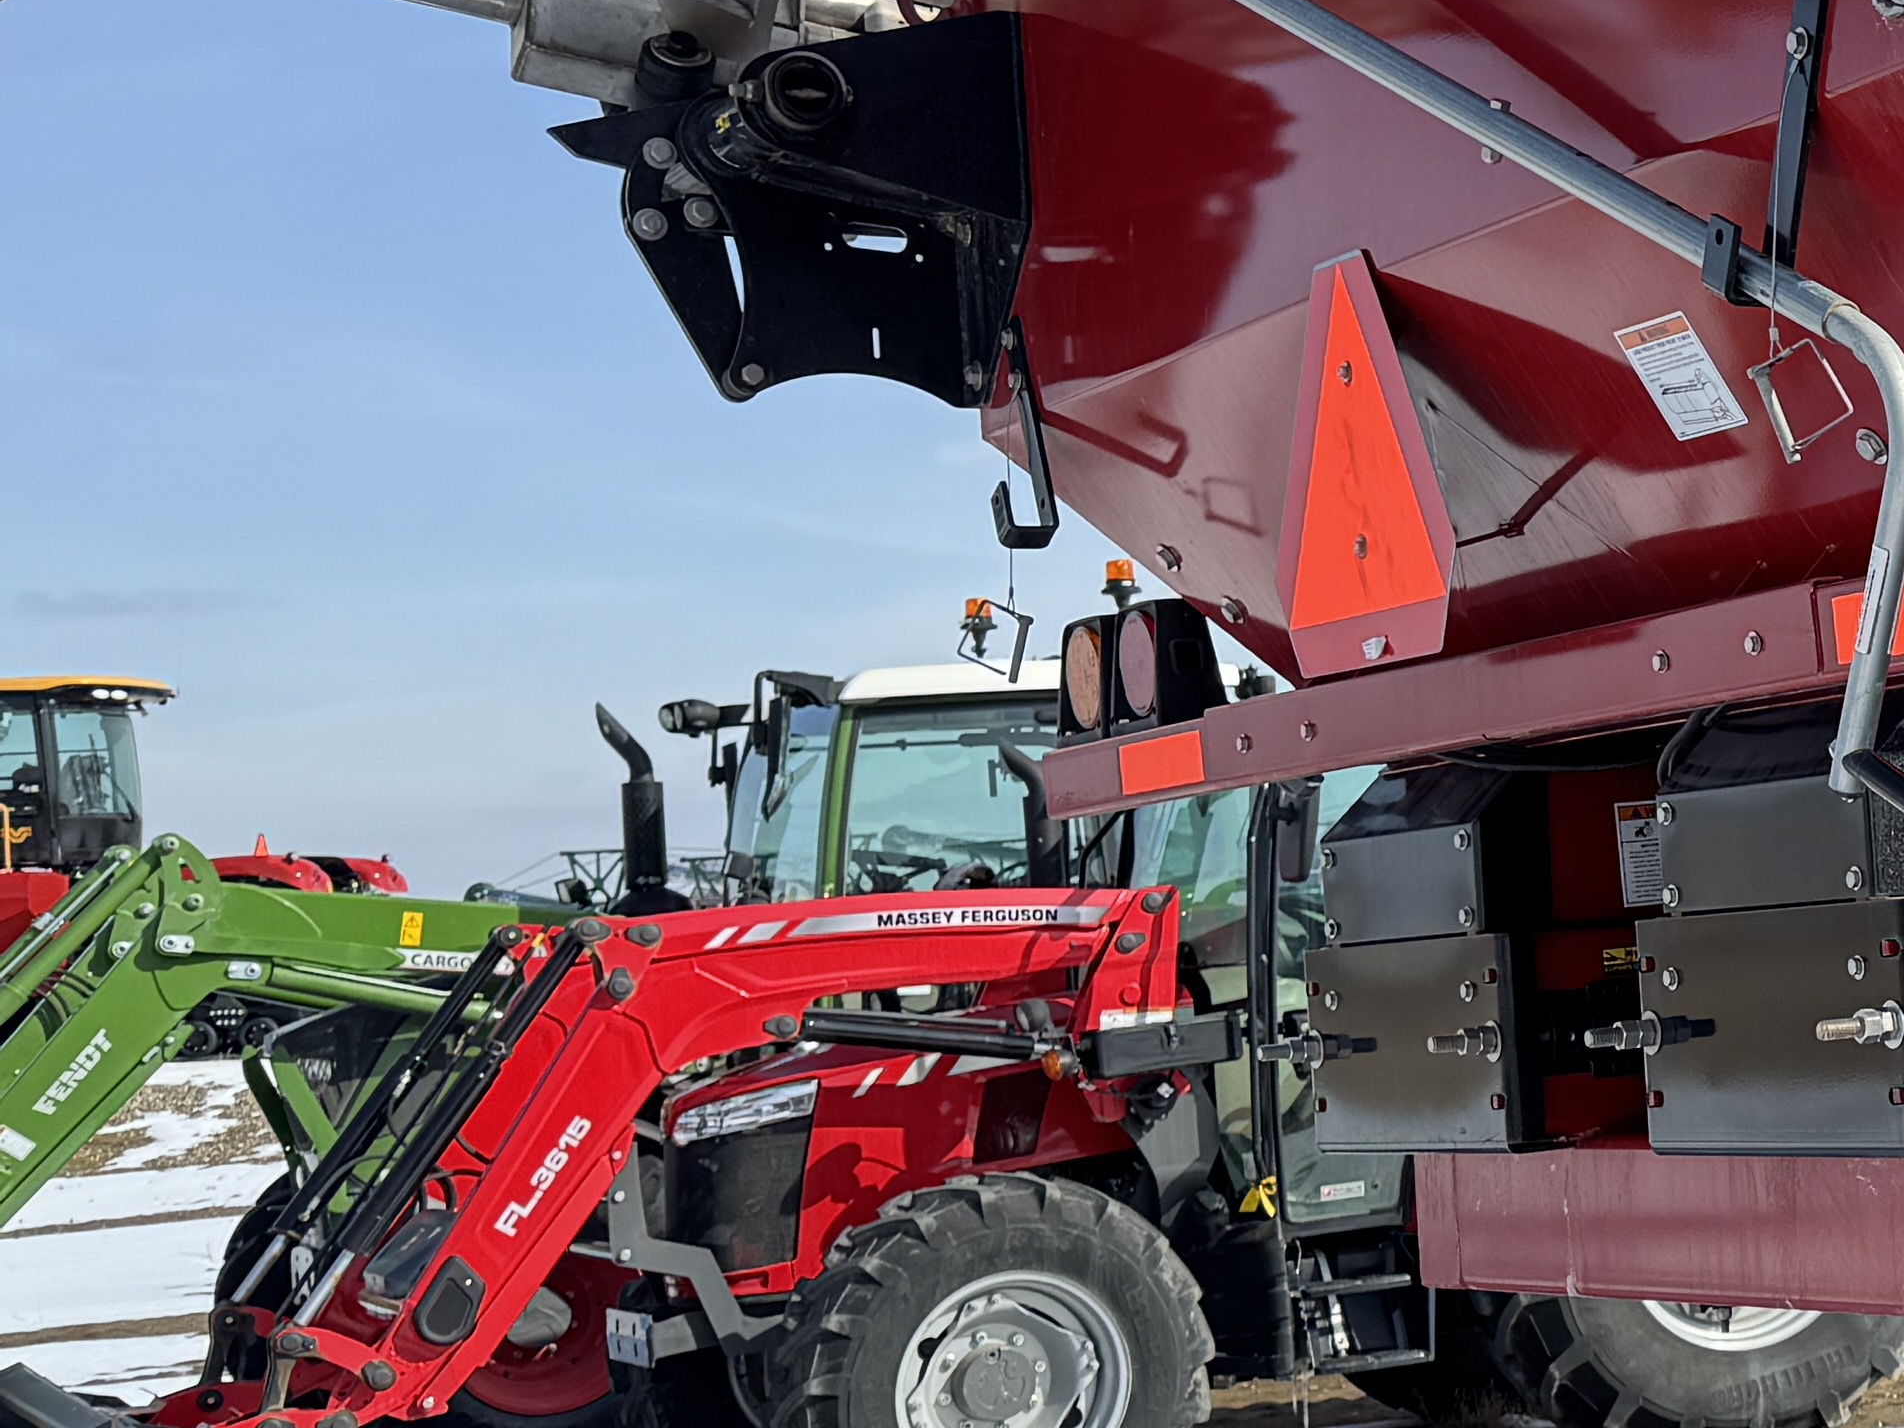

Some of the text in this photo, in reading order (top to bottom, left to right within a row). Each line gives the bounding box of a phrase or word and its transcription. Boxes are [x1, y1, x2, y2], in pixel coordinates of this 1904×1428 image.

[877, 908, 1058, 927] MASSEY FERGUSON
[411, 953, 474, 969] CARGO
[32, 1028, 113, 1115] FENDT
